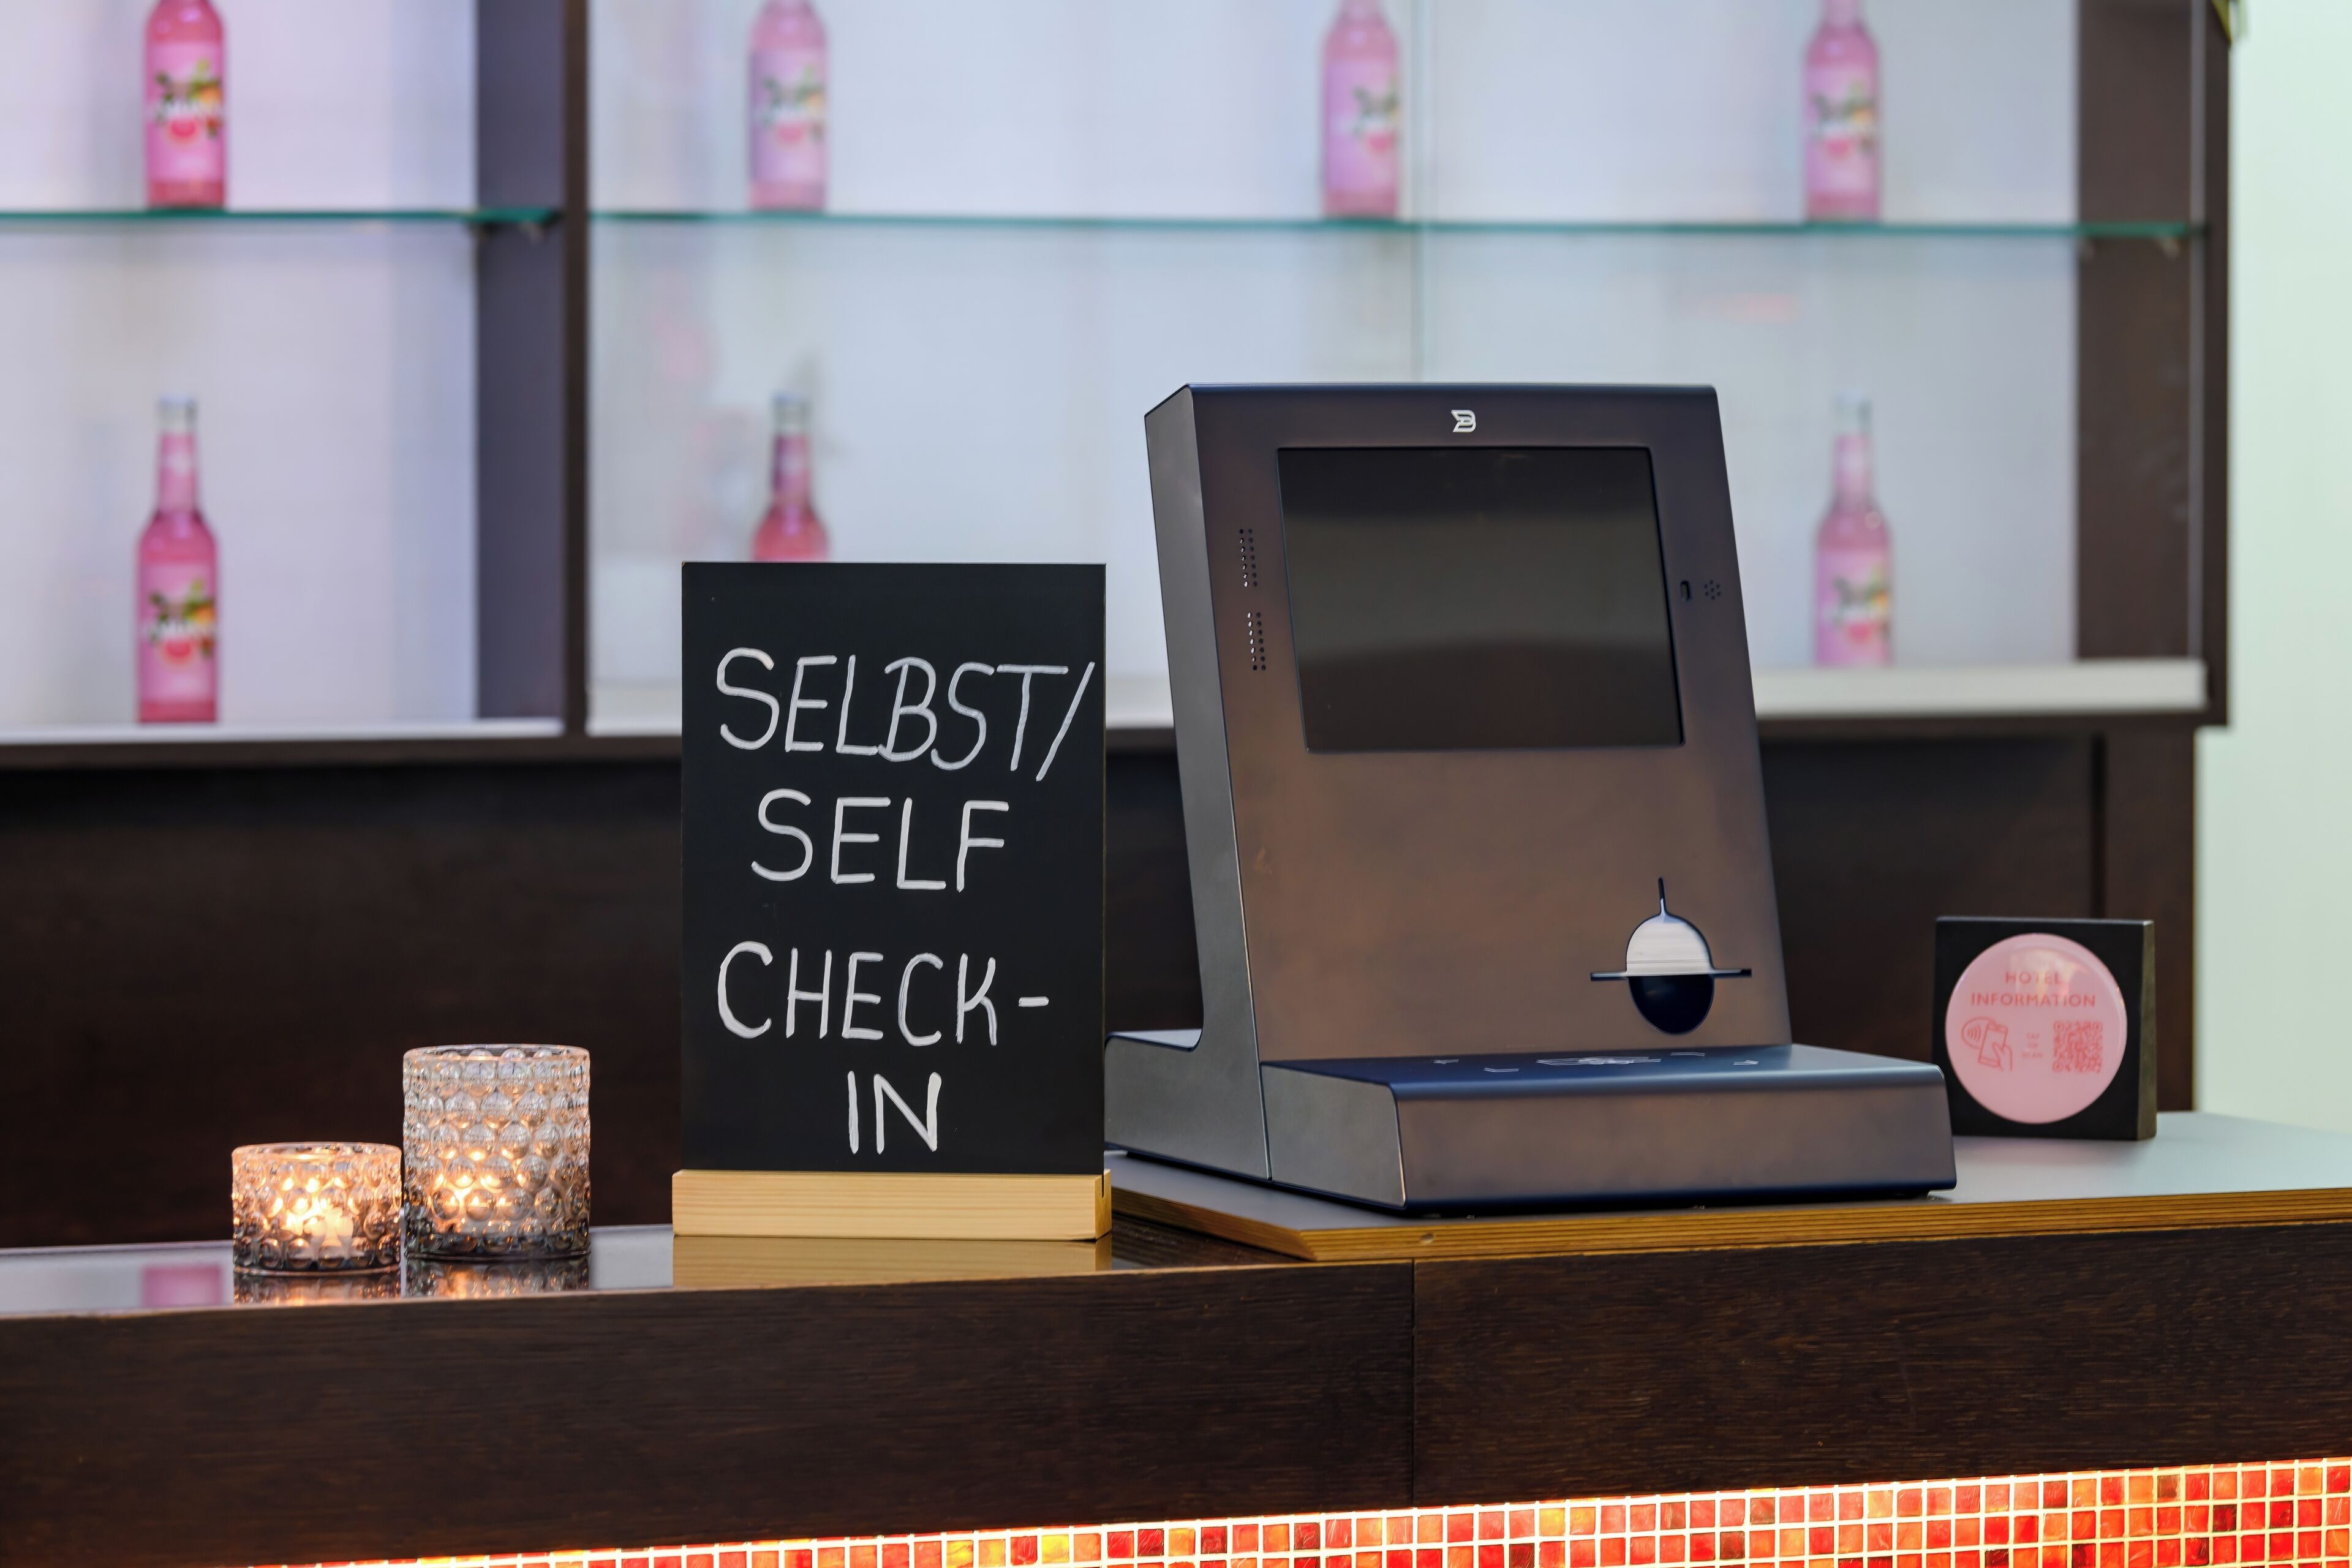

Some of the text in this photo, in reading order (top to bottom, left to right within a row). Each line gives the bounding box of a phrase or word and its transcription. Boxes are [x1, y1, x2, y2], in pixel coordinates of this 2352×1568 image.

[715, 647, 1095, 782] SELBST/
[751, 788, 1009, 892] SELF
[717, 941, 1049, 1047] CHECK-
[1970, 992, 2096, 1008] INFORMATION
[2005, 971, 2063, 985] HOTEL
[847, 1070, 942, 1155] IN
